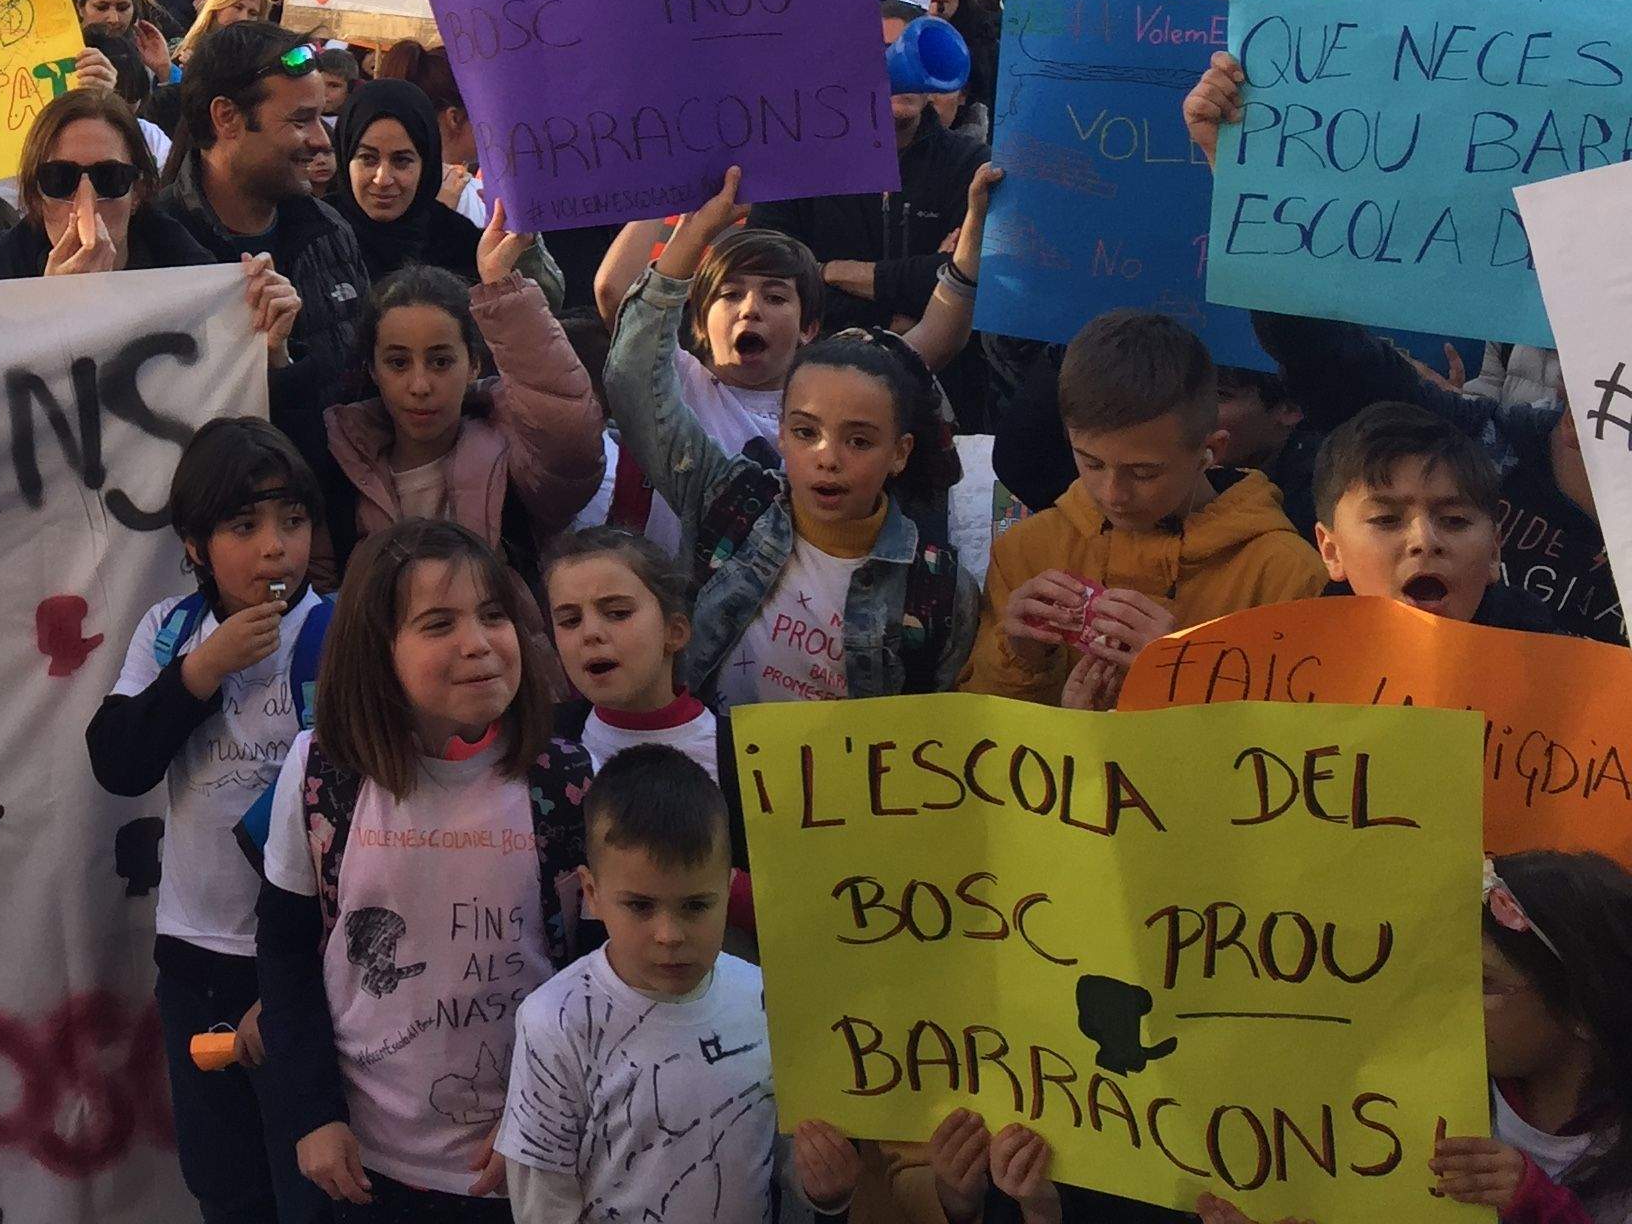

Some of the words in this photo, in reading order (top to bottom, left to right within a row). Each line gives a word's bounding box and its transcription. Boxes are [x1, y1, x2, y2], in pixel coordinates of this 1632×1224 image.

[1240, 15, 1358, 89] QUE
[1237, 101, 1420, 174] PROU
[1225, 193, 1462, 265] ESCOLA
[1490, 207, 1536, 271] D
[1230, 744, 1422, 829] DEL
[463, 951, 526, 983] ALS
[831, 871, 1079, 966] BOSC
[1145, 901, 1395, 990] PROU
